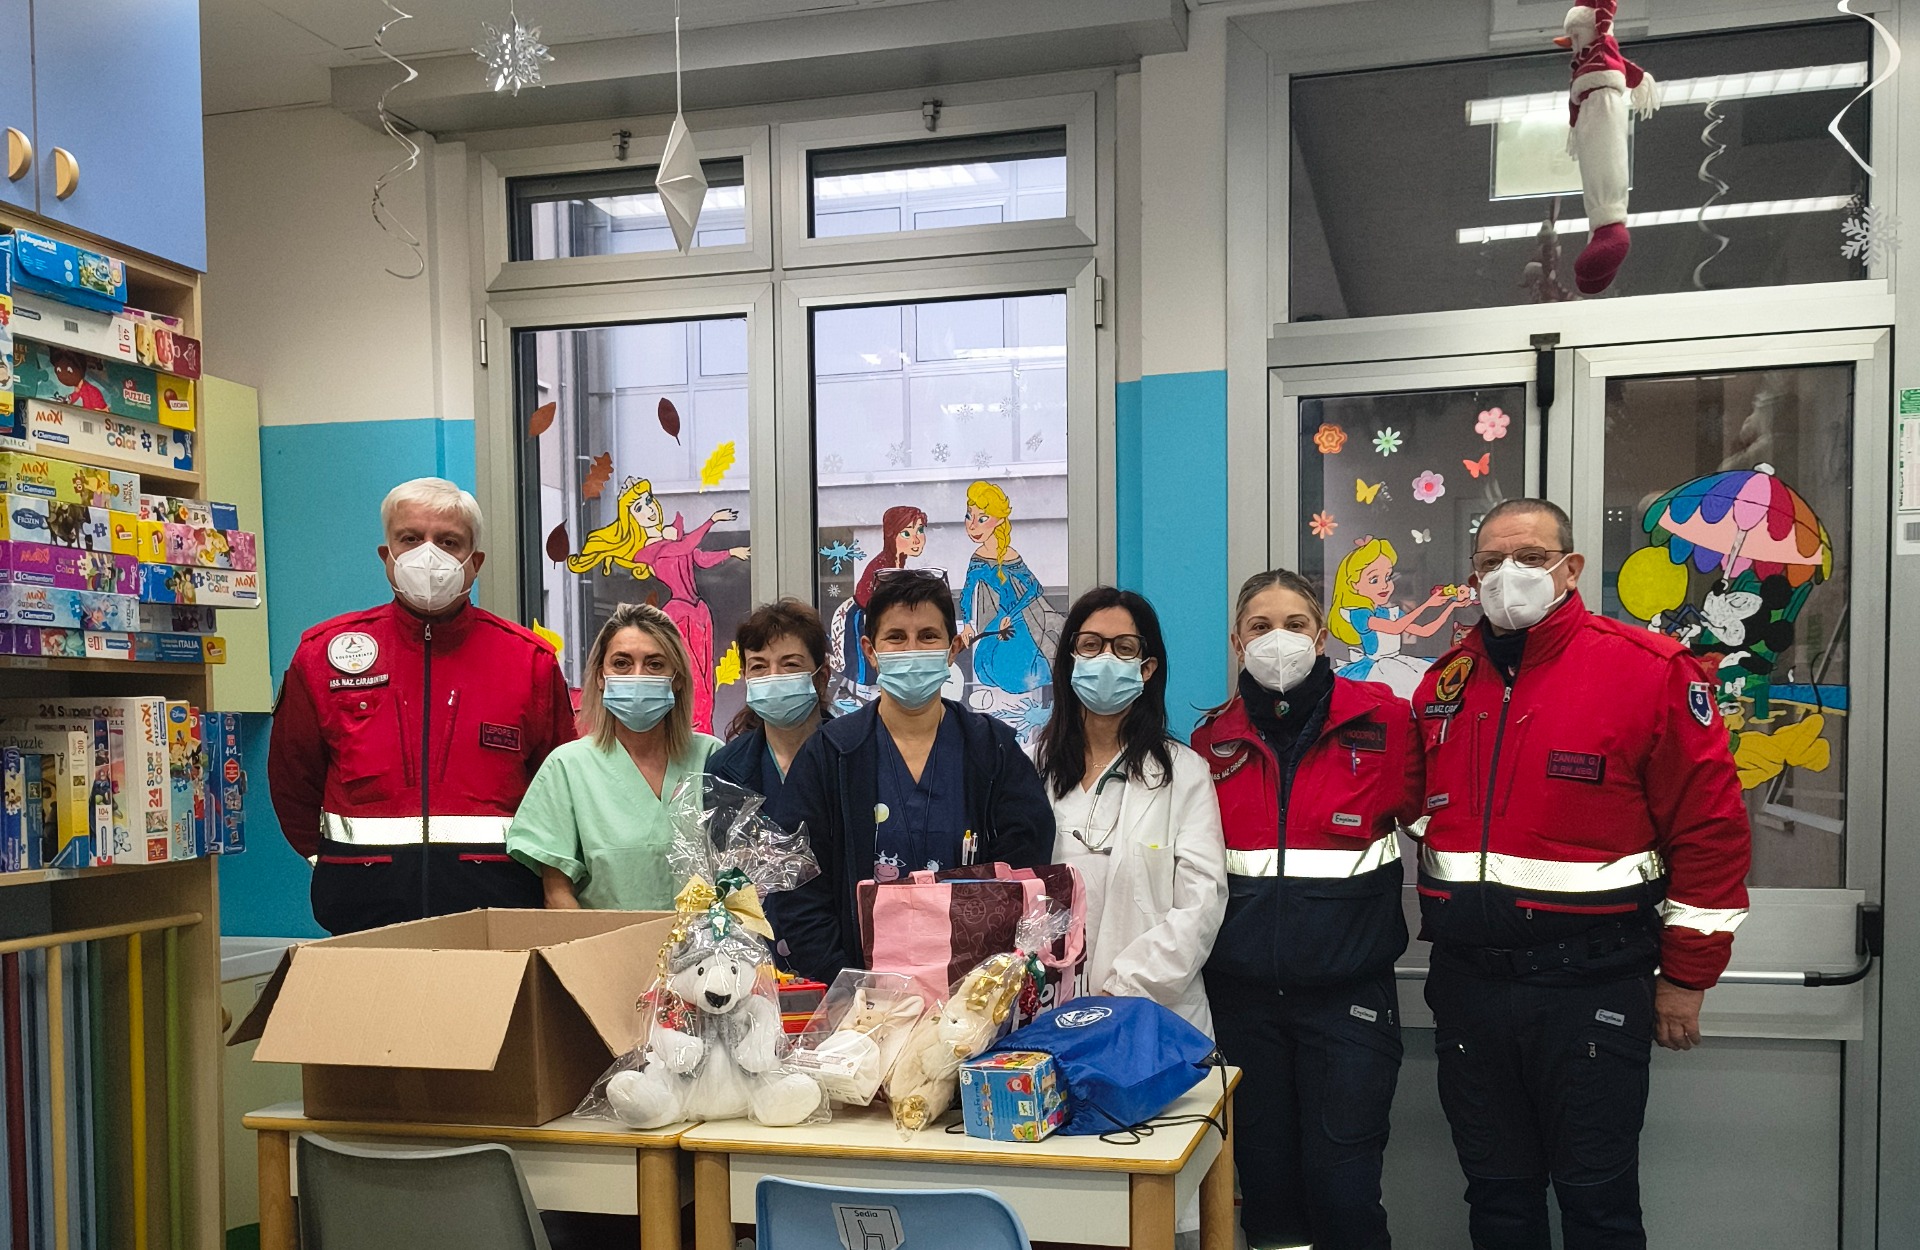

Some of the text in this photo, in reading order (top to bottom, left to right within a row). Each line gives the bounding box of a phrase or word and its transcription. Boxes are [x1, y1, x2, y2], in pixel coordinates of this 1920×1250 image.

[20, 233, 57, 251] playmobil
[124, 390, 150, 403] PUZZLE
[105, 418, 136, 437] Super
[38, 431, 69, 443] Clementoni
[107, 433, 136, 450] Color
[23, 484, 55, 496] Clementoni
[17, 516, 40, 525] FROZEN
[205, 571, 228, 583] Super
[207, 582, 229, 593] Color
[178, 639, 199, 649] ITALIA
[341, 678, 355, 686] NAZ.
[40, 704, 55, 717] 24
[10, 735, 44, 749] Puzzle
[146, 752, 155, 787] Super
[155, 751, 163, 785] Color
[149, 788, 159, 808] 24
[98, 808, 109, 816] 104
[854, 1210, 878, 1219] Sedia
